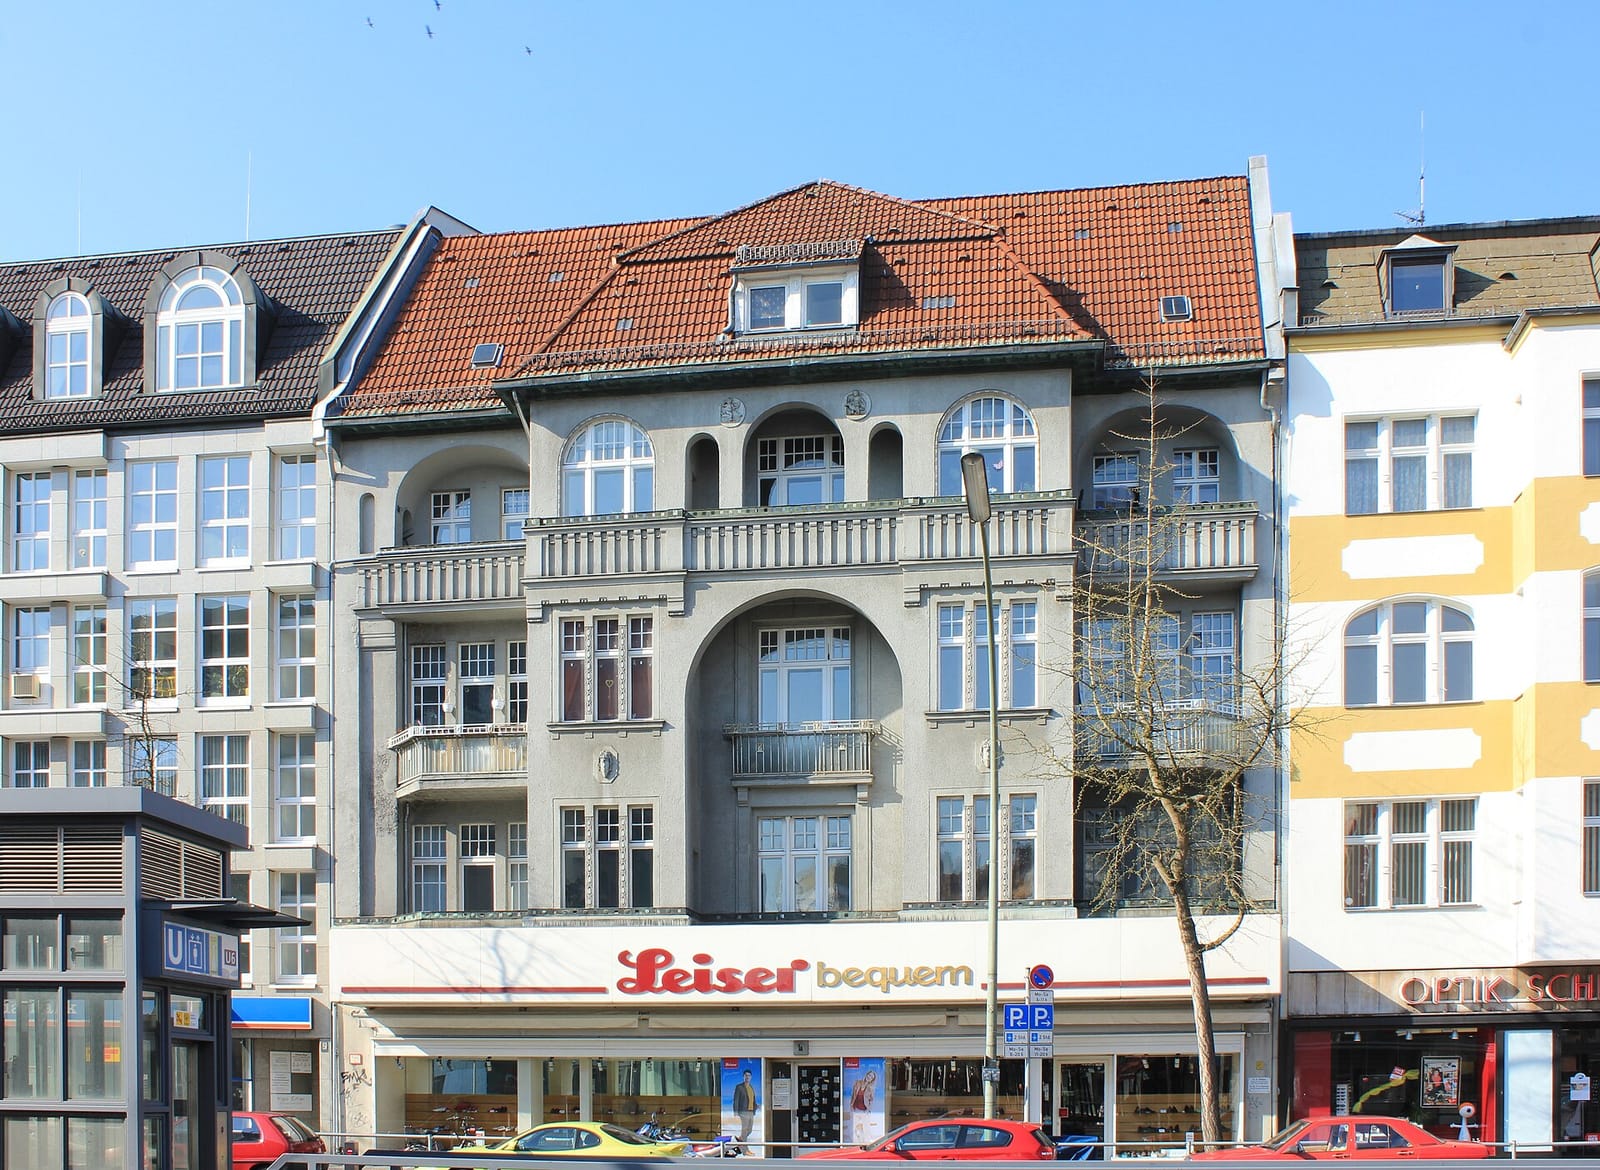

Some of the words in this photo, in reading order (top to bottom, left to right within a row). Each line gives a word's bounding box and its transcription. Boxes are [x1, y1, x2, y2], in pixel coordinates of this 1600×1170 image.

[168, 928, 183, 965] U
[225, 949, 236, 965] U6
[617, 948, 810, 993] Leiser
[817, 961, 973, 993] bequem
[1399, 976, 1504, 1005] OPTIK
[1010, 1007, 1024, 1027] P
[1034, 1007, 1048, 1027] P
